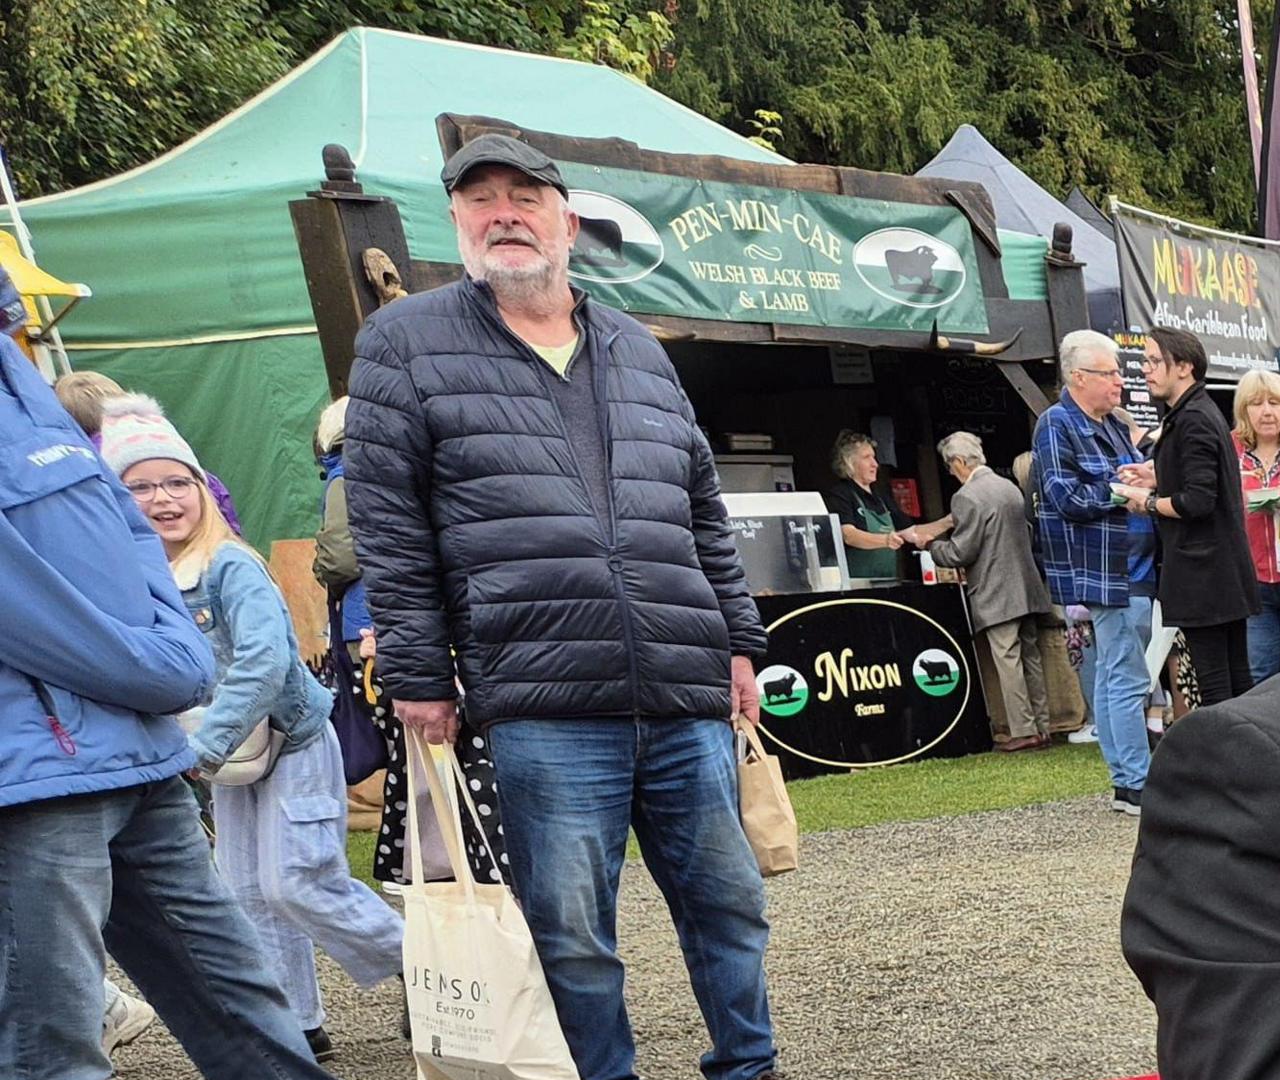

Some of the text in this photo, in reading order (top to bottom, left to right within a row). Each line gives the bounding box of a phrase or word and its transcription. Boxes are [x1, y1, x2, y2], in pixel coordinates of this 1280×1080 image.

[669, 200, 843, 264] PEN-MIN-CAE
[688, 261, 841, 291] WELSH BLACK BEEF
[1153, 236, 1261, 309] MUKAASE
[738, 290, 809, 312] & LAMB
[1114, 333, 1147, 346] MUKAA
[1240, 313, 1267, 341] Food
[855, 703, 885, 717] Farms
